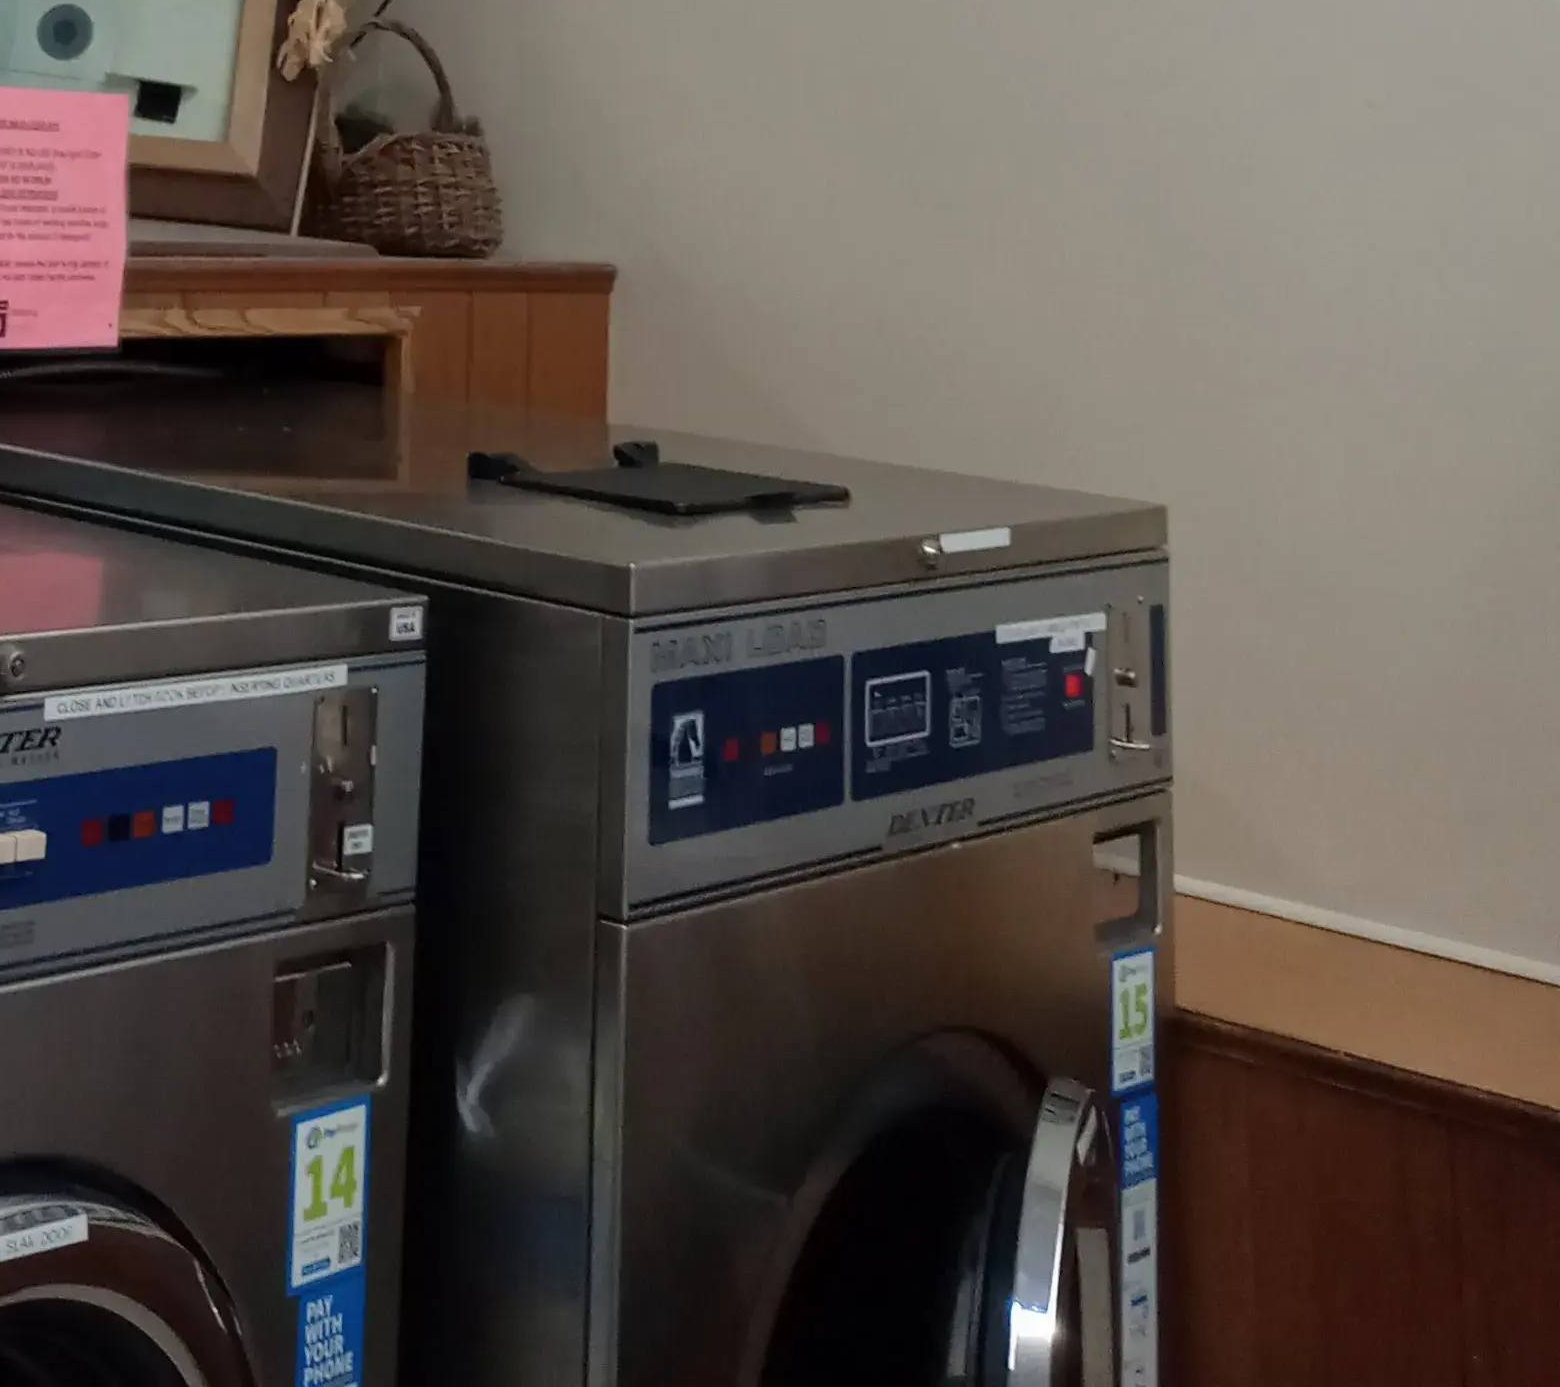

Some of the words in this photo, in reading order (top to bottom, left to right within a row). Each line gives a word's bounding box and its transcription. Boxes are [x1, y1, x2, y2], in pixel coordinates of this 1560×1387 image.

[1119, 982, 1148, 1040] 15
[303, 1145, 358, 1222] 14
[306, 1294, 333, 1319] PAY
[305, 1312, 343, 1345] WITH
[304, 1333, 345, 1368] YOUR
[302, 1351, 354, 1387] PHONE
